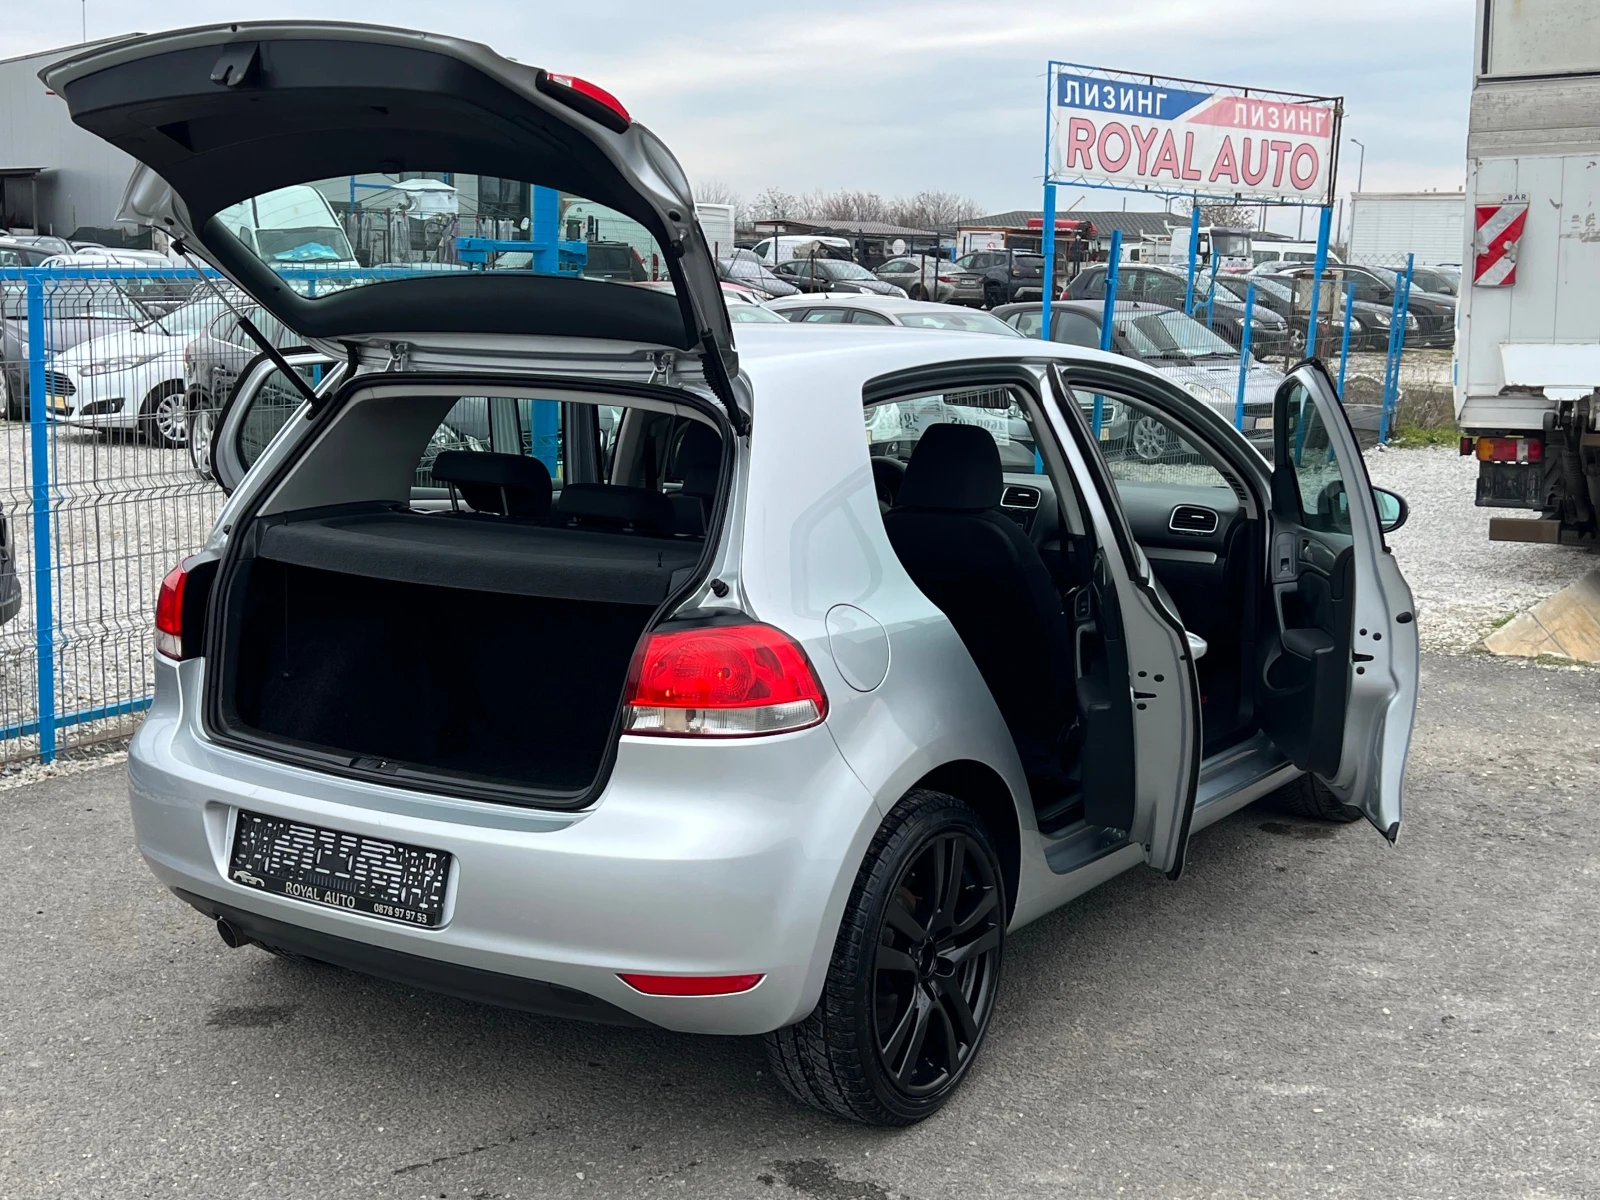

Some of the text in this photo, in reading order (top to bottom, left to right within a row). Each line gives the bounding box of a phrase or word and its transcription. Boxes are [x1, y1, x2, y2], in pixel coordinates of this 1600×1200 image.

[1064, 80, 1168, 116] ЛИЗИНГ
[1233, 103, 1326, 133] ЛИЗИНГ
[1066, 116, 1319, 190] ROYAL AUTO
[285, 881, 356, 909] ROYAL AUTO
[373, 903, 428, 924] 0878 97 97 53
